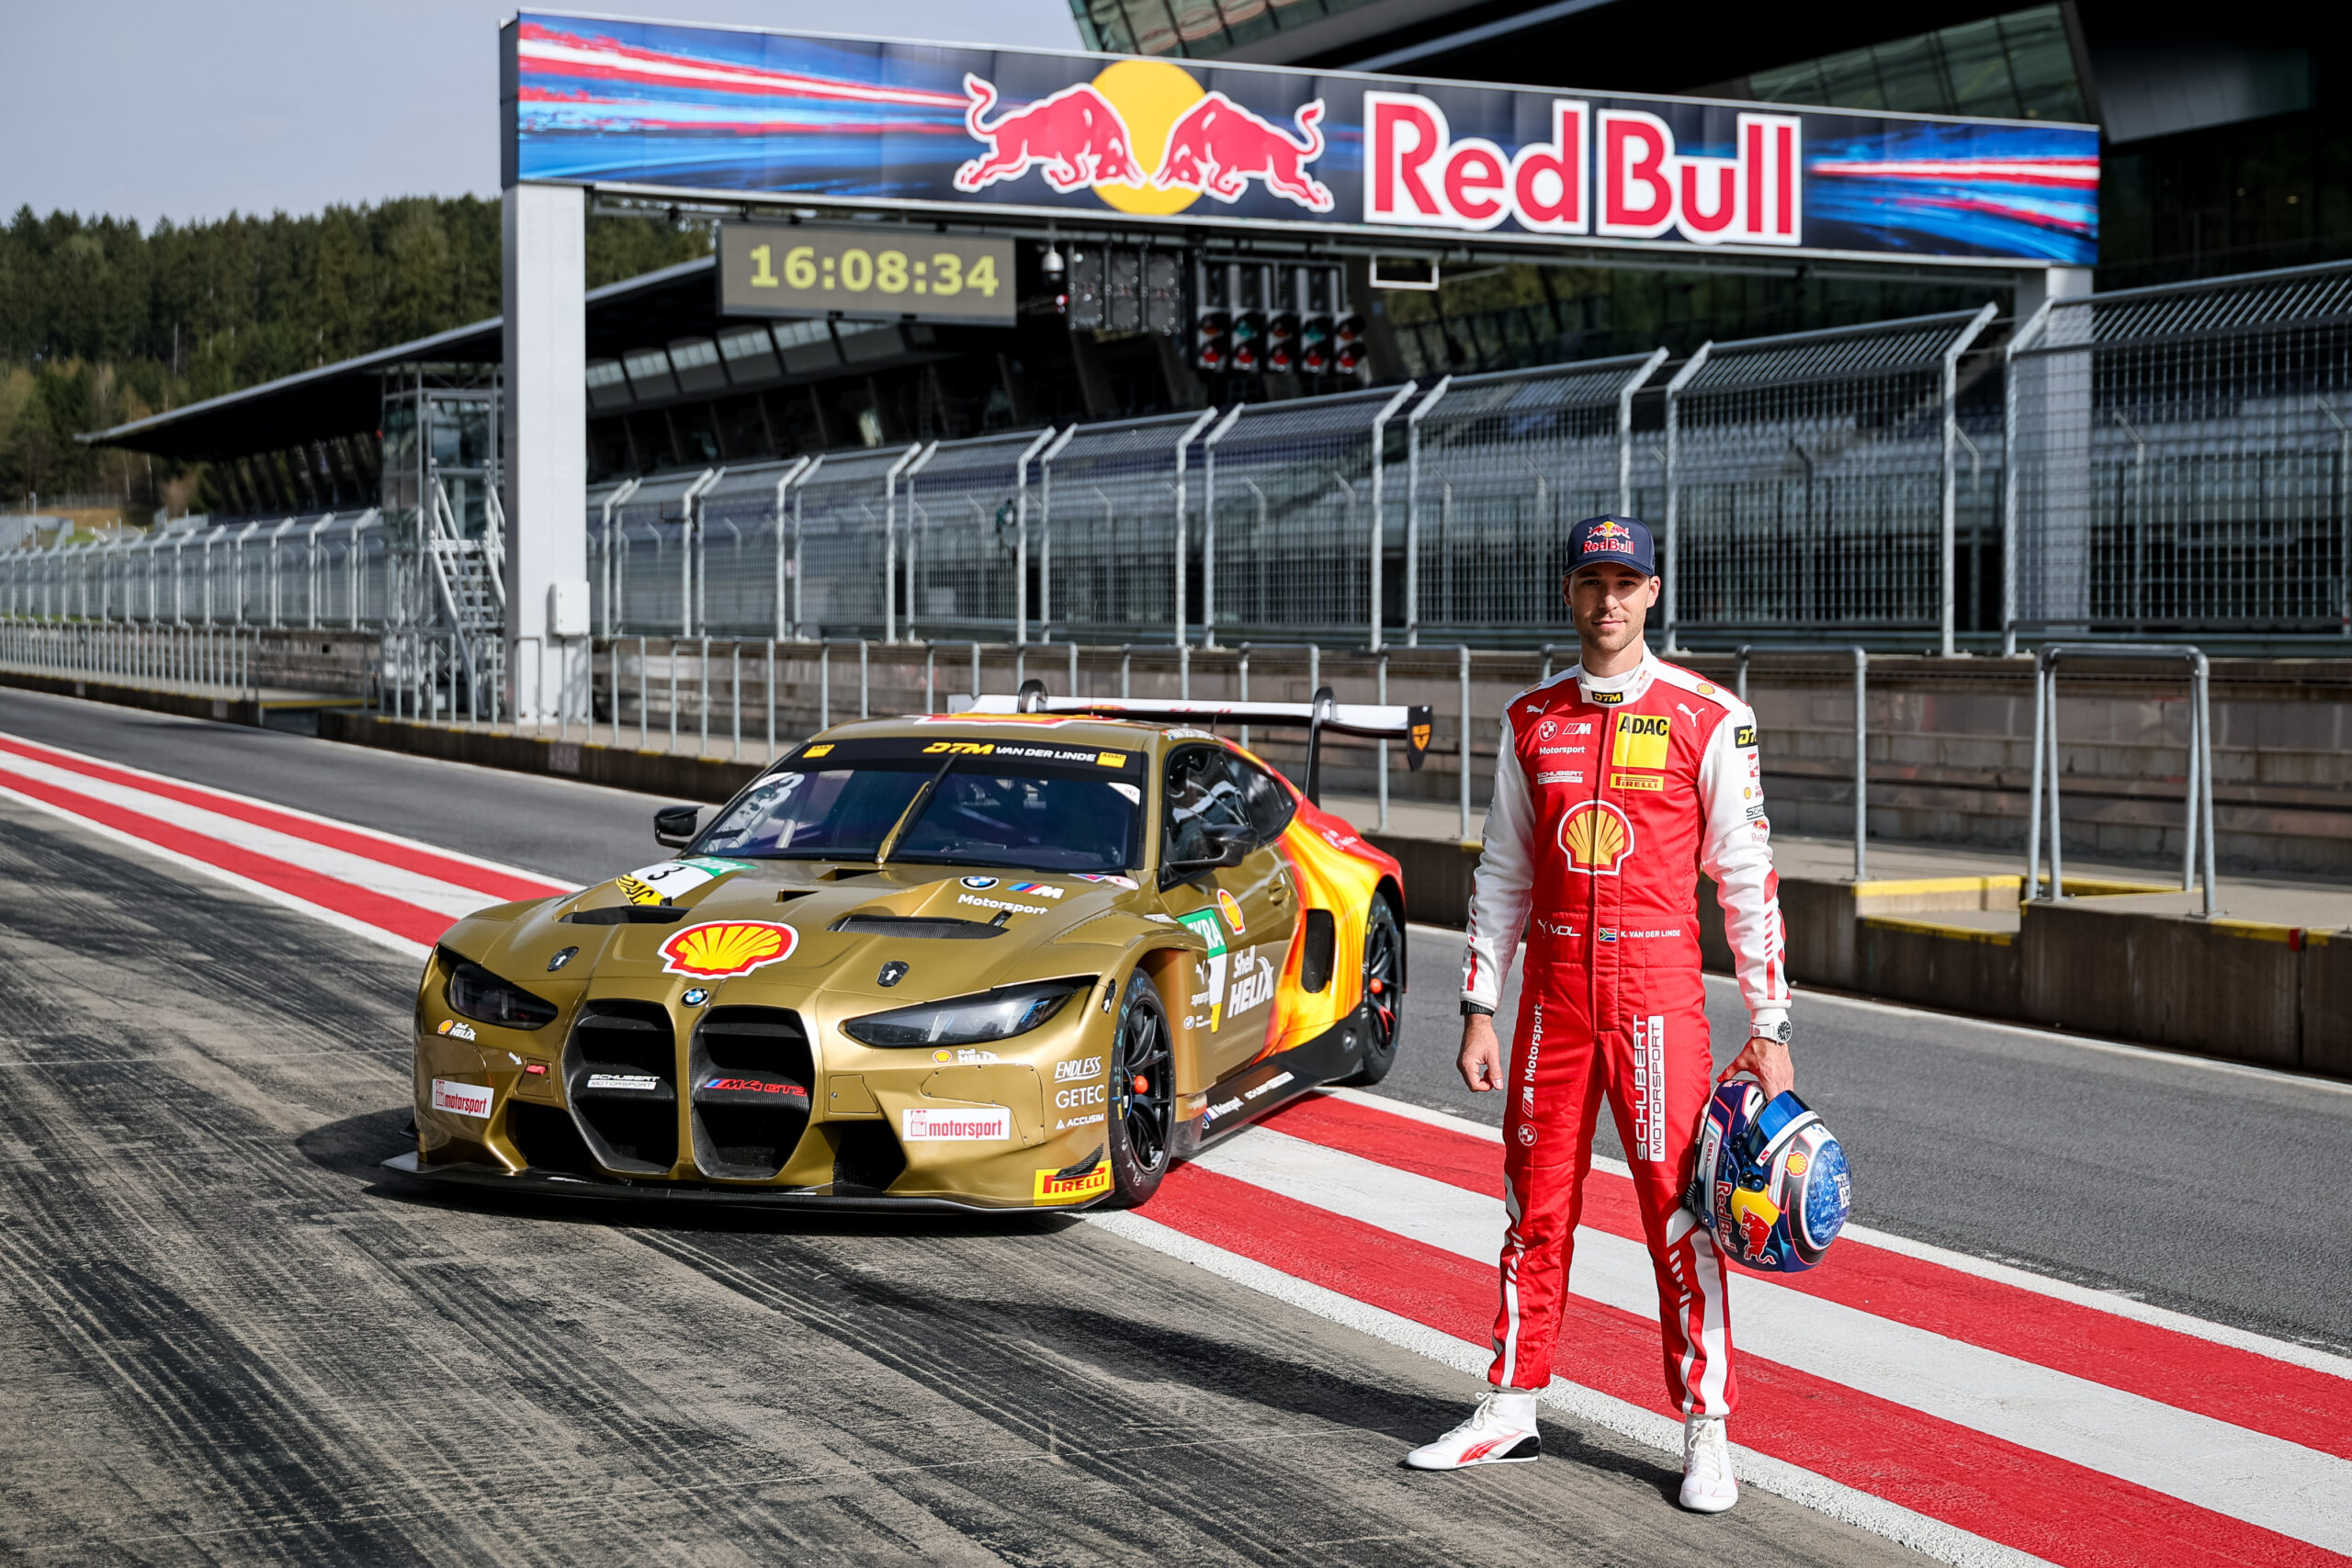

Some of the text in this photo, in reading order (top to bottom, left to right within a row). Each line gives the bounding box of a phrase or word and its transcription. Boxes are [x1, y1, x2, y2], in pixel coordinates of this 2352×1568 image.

[1366, 93, 1801, 244] Red Bull
[750, 244, 1000, 299] 16:08:34
[1583, 537, 1635, 556] Red Bull
[1594, 693, 1622, 702] DTM
[1618, 716, 1668, 737] ADAC
[1737, 728, 1757, 745] DT
[922, 741, 1097, 762] DTM VAN DER LINDE
[1539, 745, 1586, 756] Motorsport
[1615, 775, 1659, 789] PIRELLI
[647, 866, 684, 881] 3
[957, 894, 1048, 915] Motorsport
[1233, 944, 1256, 978] Shell
[1227, 960, 1275, 1019] HELIX
[449, 1027, 476, 1041] HELIX
[1524, 1003, 1544, 1082] Motorsport
[956, 1048, 976, 1056] Shell
[957, 1054, 1000, 1064] HELIX
[590, 1073, 661, 1082] SCHUBERT
[1054, 1056, 1102, 1080] ENDLESS
[590, 1080, 654, 1089] MOTORSPORT
[722, 1078, 808, 1097] M4 GT3
[1633, 1014, 1648, 1161] SCHUBERT
[1651, 1022, 1662, 1155] MOTORSPORT
[445, 1093, 487, 1114] motorsport
[1055, 1084, 1105, 1109] GETEC
[929, 1119, 1002, 1139] motorsport
[1066, 1113, 1105, 1128] ACCUSIM
[1043, 1166, 1106, 1194] PIRELLI
[1716, 1180, 1733, 1220] Red
[1717, 1218, 1738, 1254] Bull
